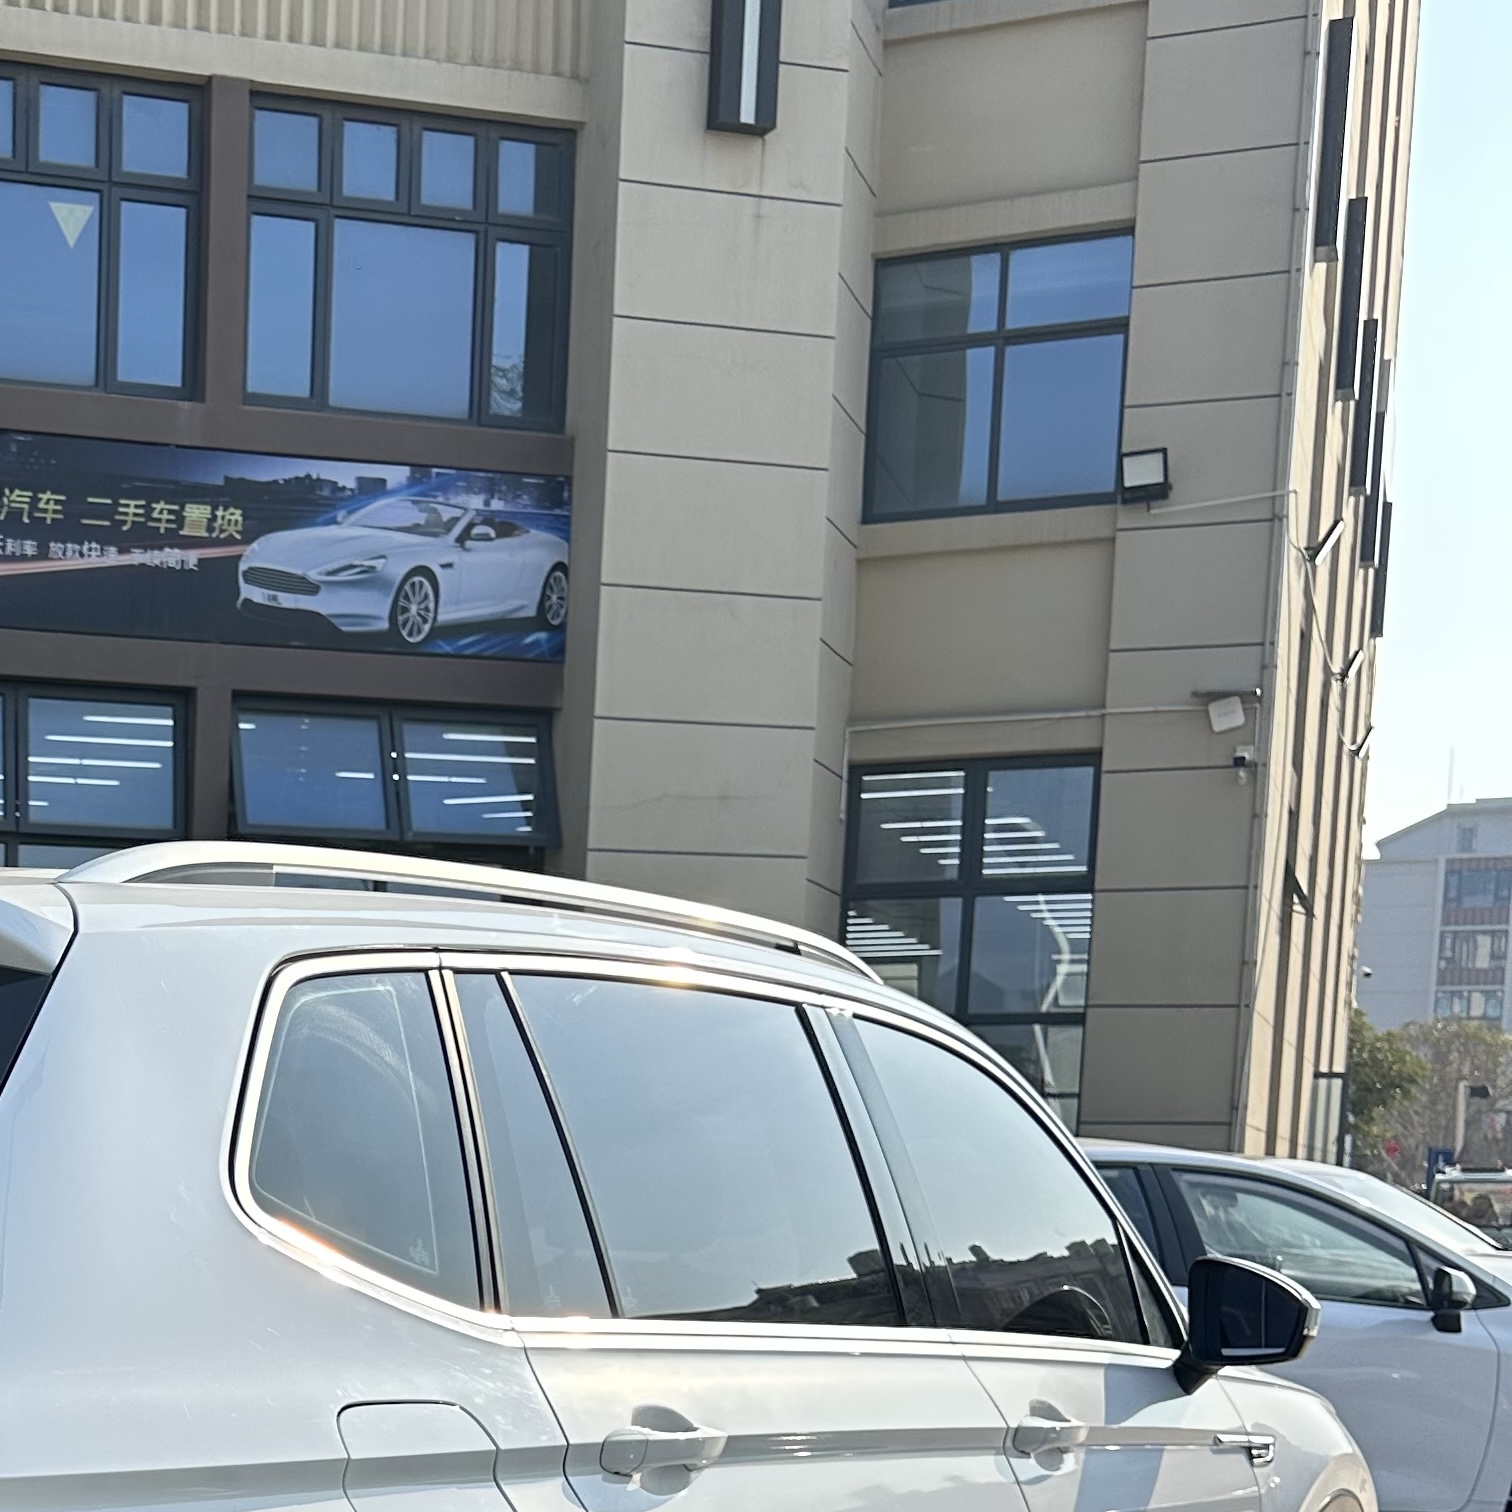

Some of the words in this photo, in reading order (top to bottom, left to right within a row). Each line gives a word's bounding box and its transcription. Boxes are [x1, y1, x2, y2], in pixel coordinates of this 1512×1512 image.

[80, 497, 244, 540] 二手车置换
